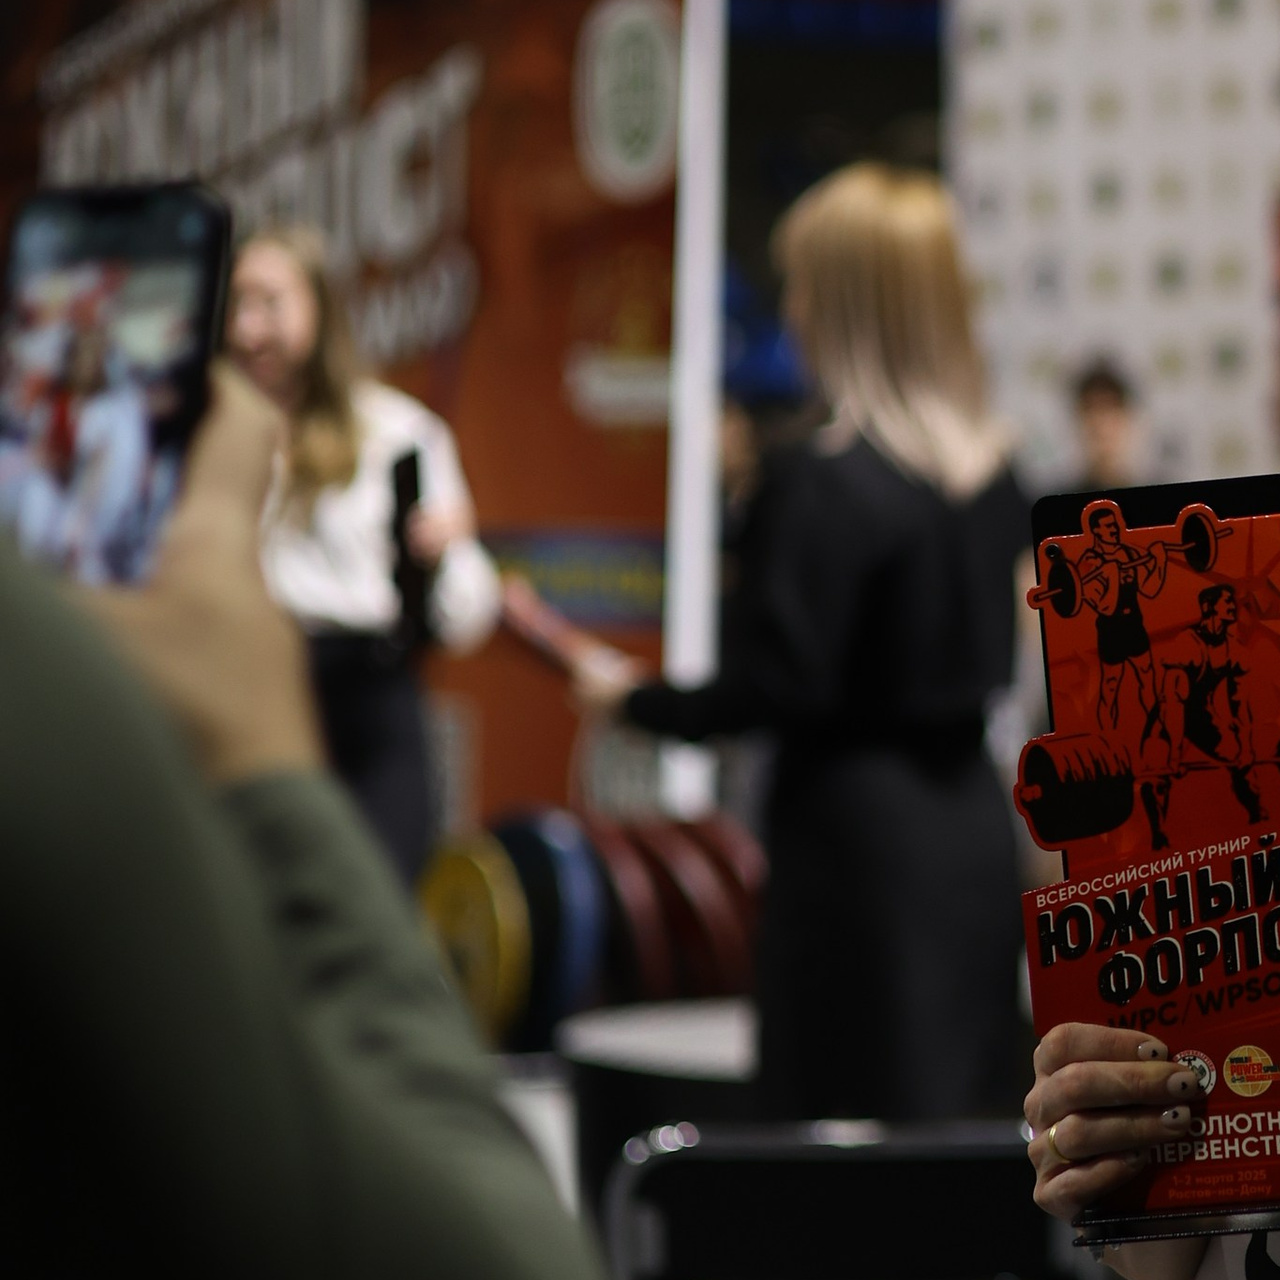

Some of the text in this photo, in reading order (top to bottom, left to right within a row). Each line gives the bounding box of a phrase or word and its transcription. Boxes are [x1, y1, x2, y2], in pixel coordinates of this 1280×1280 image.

[1036, 835, 1251, 908] ВСЕРОССИЙСКИЙ ТУРНИР
[1230, 1063, 1263, 1076] POWER
[1237, 1170, 1267, 1182] 2025
